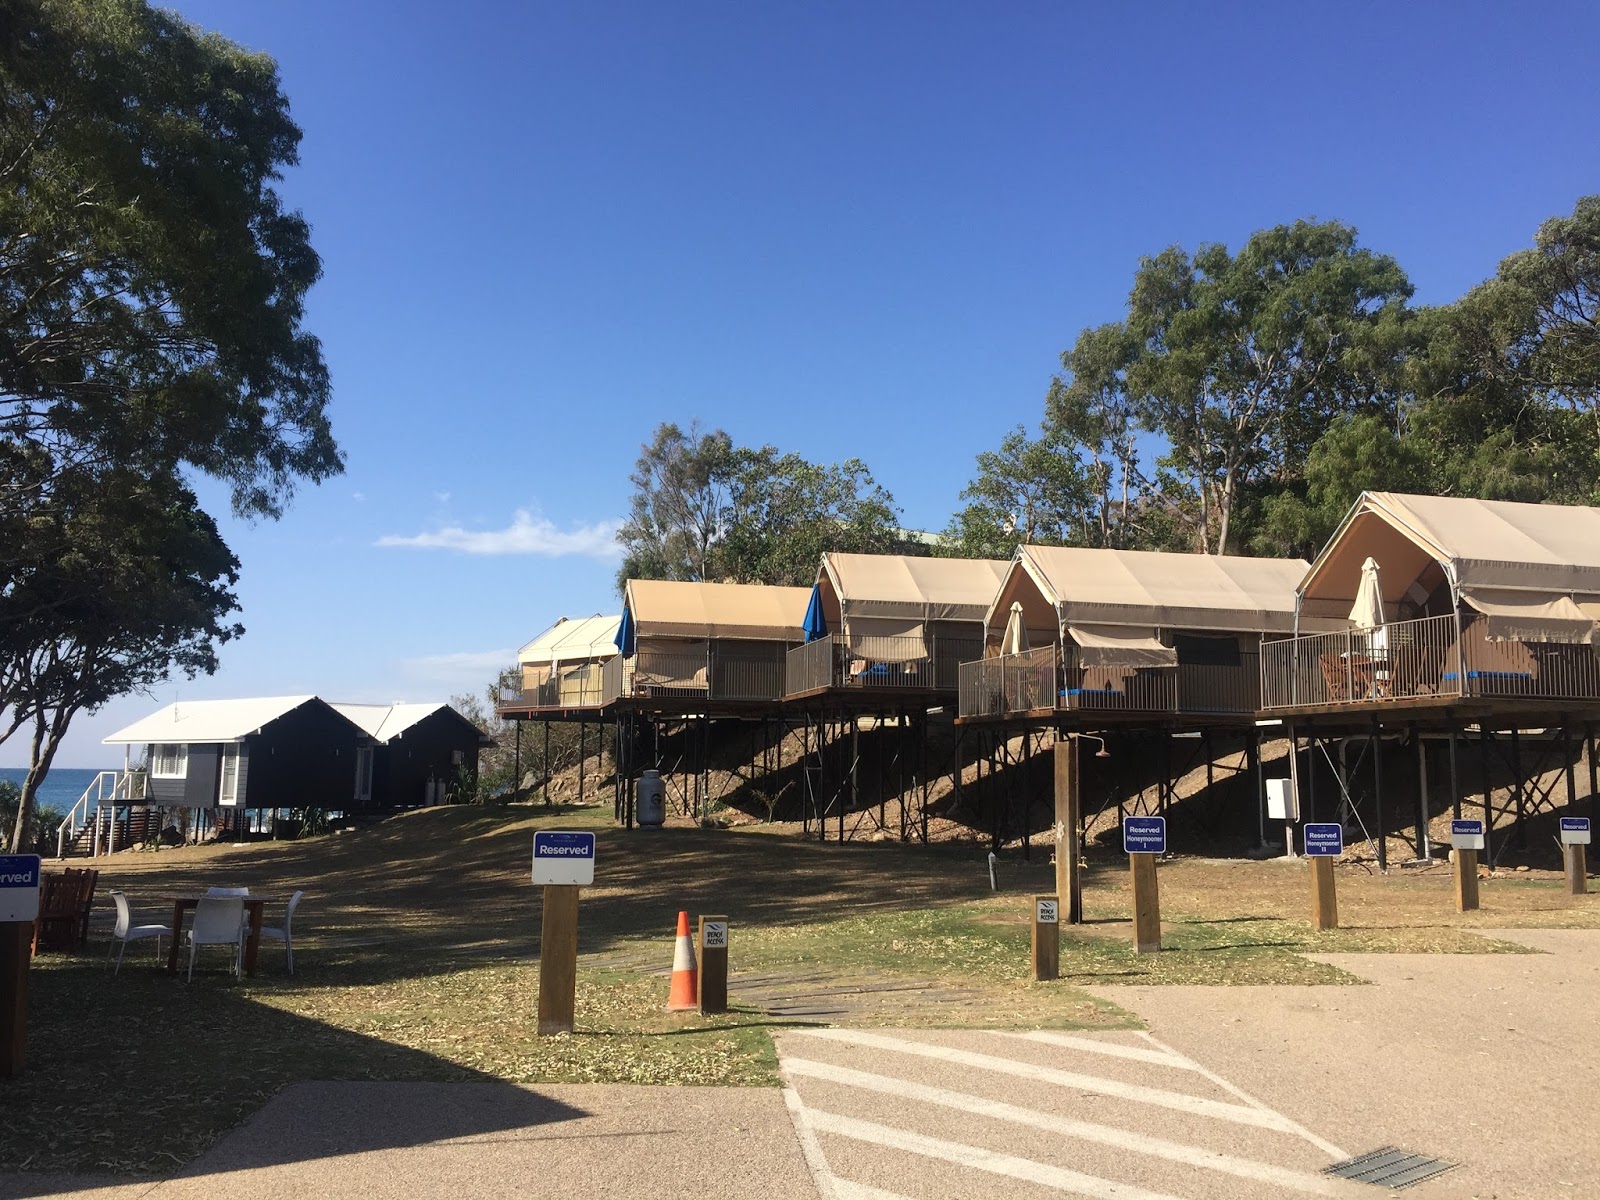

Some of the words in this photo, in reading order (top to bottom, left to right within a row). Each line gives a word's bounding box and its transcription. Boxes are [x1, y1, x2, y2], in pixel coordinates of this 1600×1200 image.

[1126, 835, 1163, 843] Honeymooner
[539, 845, 589, 855] Reserved
[0, 870, 32, 883] rved
[706, 931, 723, 939] BEACH
